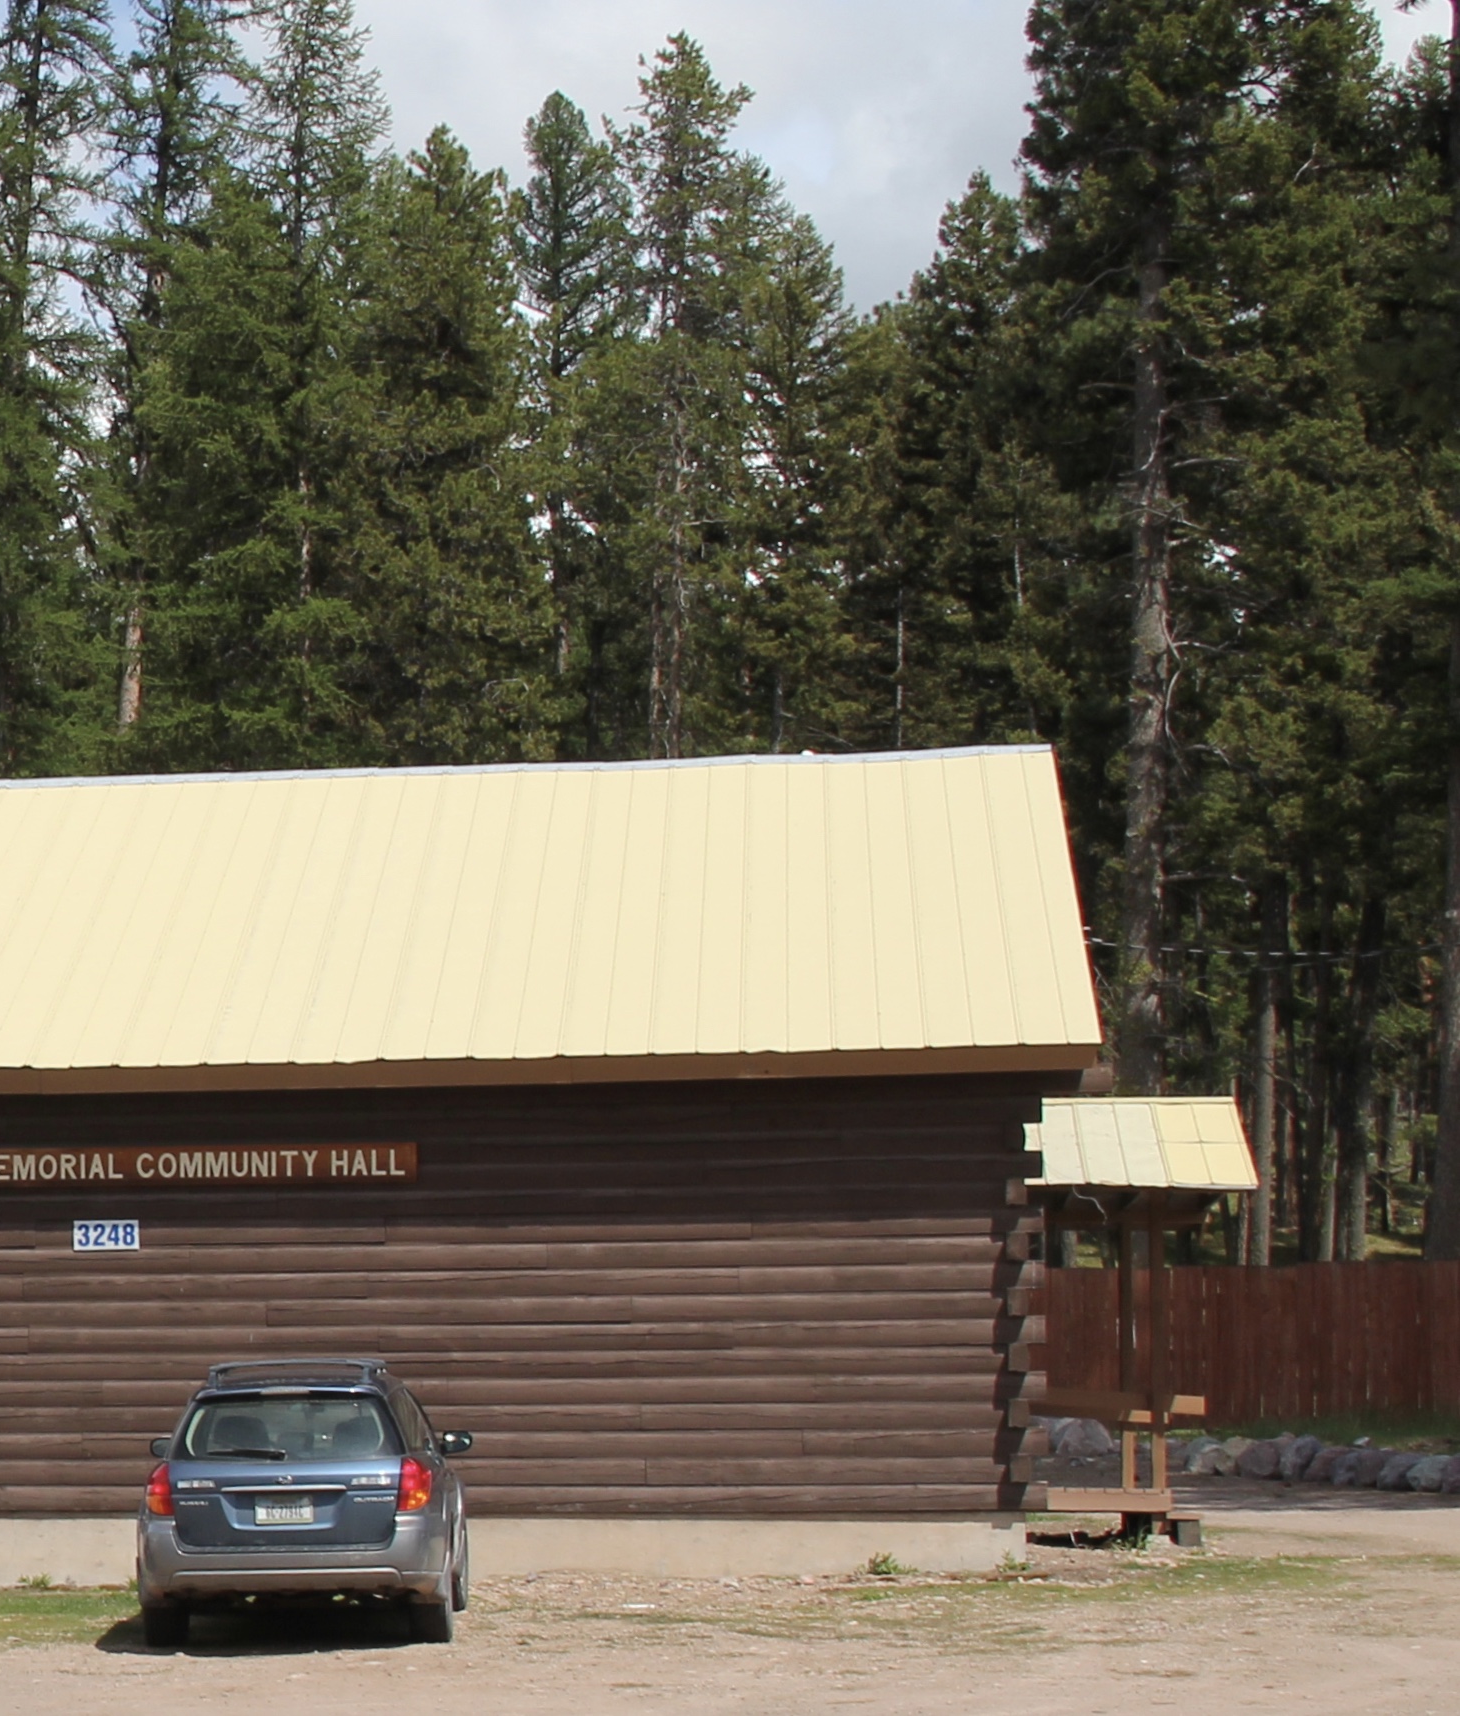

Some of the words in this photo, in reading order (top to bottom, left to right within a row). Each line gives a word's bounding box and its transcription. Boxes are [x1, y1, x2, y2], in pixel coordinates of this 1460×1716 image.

[136, 1150, 318, 1179] COMMUNITY
[331, 1148, 406, 1177] HALL
[77, 1223, 136, 1247] 3248
